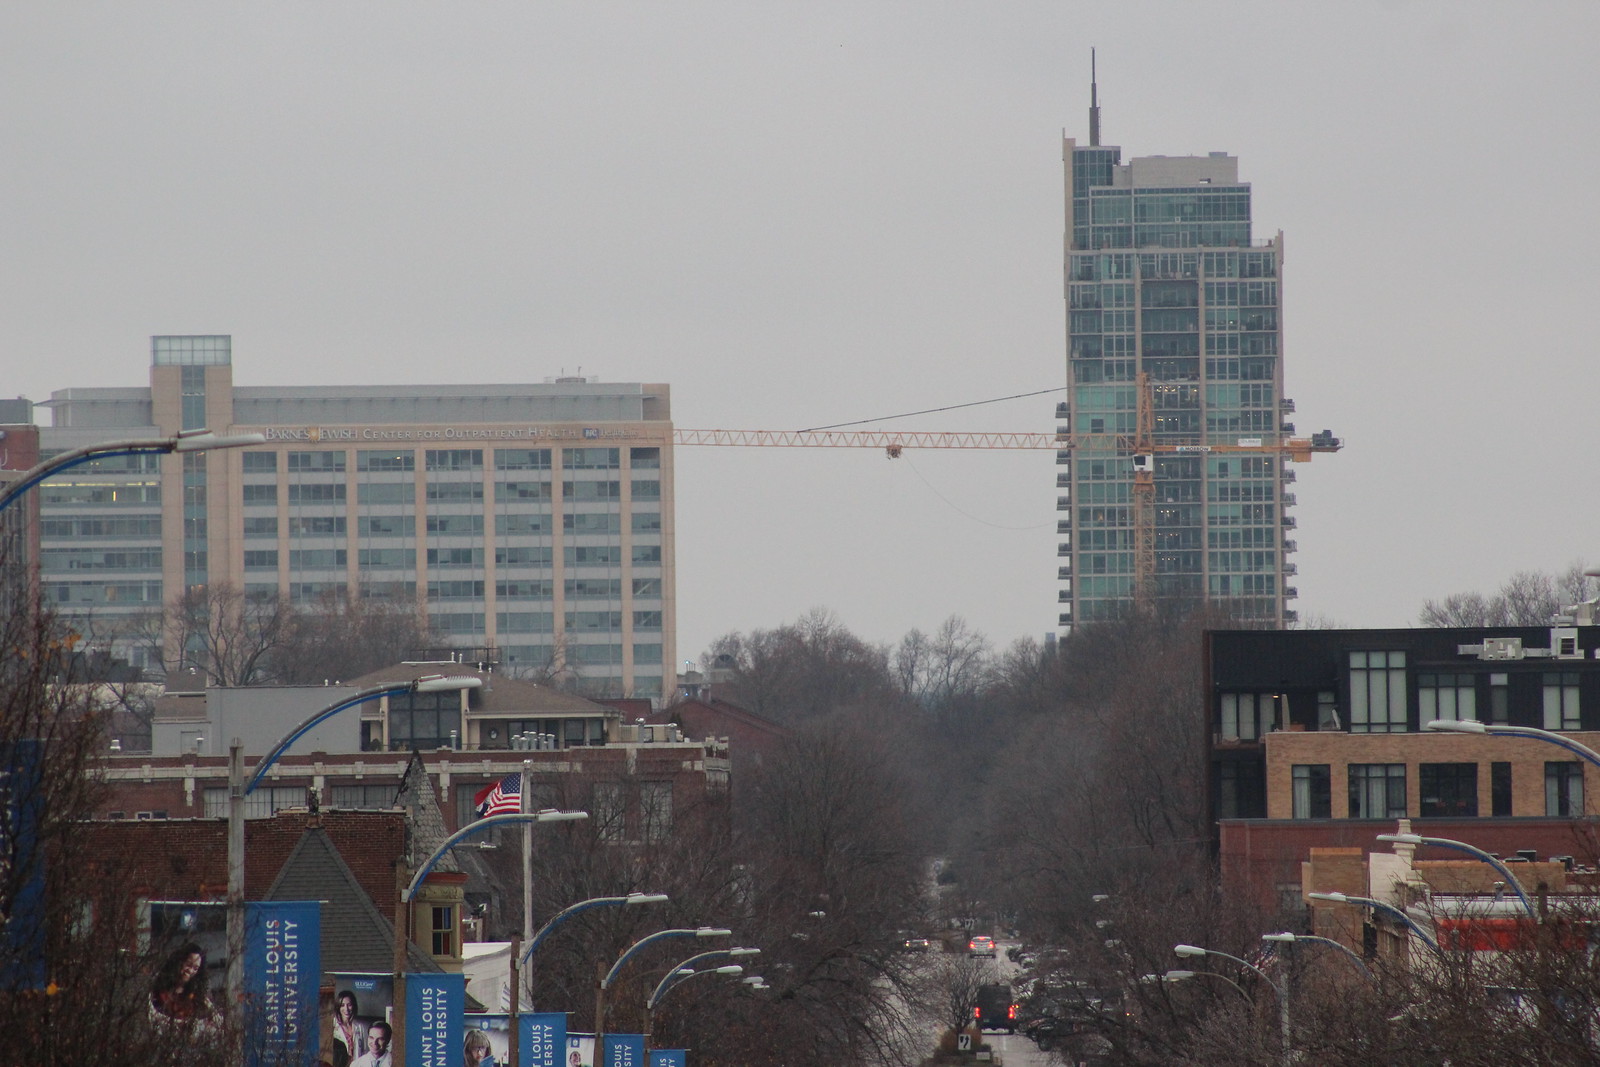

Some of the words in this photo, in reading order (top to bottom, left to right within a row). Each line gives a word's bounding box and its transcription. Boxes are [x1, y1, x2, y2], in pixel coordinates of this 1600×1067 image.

[265, 428, 309, 440] BARNES
[318, 428, 358, 440] JEWISH
[363, 428, 411, 440] CENTER
[416, 430, 441, 439] FOR
[444, 427, 524, 439] OUTPATIENT
[527, 427, 576, 438] HEALTH
[266, 919, 279, 974] LOUIS
[284, 920, 298, 1034] UNIVERSITY
[266, 980, 279, 1034] SAINT
[422, 987, 433, 1030] LOUIS
[436, 988, 447, 1066] NIVERSITY
[422, 1035, 433, 1067] AINT
[532, 1024, 542, 1059] LOUIS
[544, 1024, 553, 1066] ERSITY
[614, 1044, 622, 1067] OUIS
